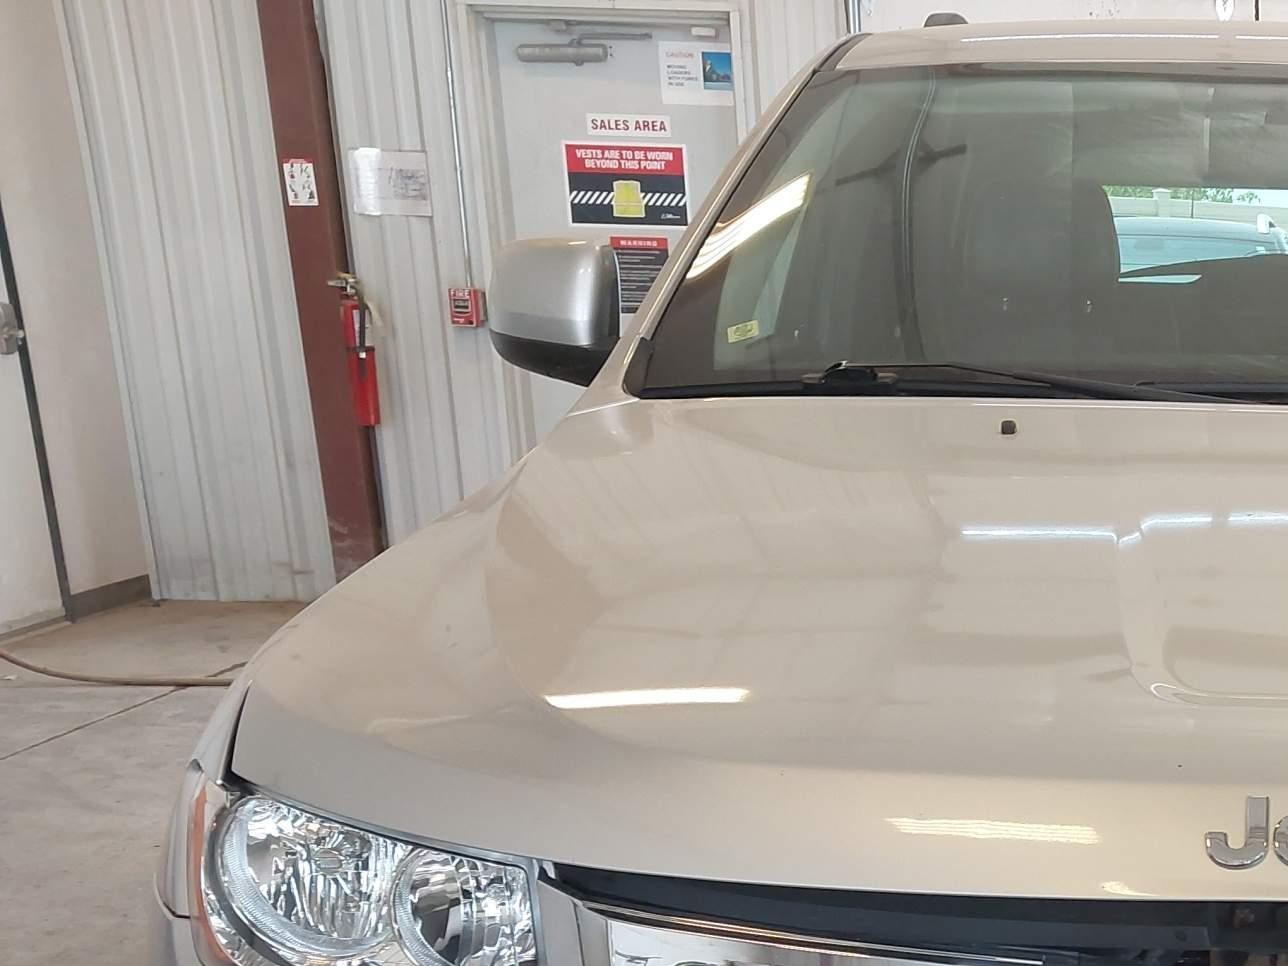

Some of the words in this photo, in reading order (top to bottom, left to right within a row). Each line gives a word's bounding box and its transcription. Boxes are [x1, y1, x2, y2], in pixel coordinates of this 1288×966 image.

[591, 119, 630, 131] SALES
[634, 120, 667, 132] AREA
[575, 149, 602, 159] VESTS
[603, 150, 620, 159] ARE
[621, 150, 633, 160] TO
[634, 151, 645, 160] BE
[646, 151, 673, 161] WORN
[584, 159, 619, 169] BEYOND
[620, 160, 639, 170] THIS
[640, 160, 666, 170] POINT
